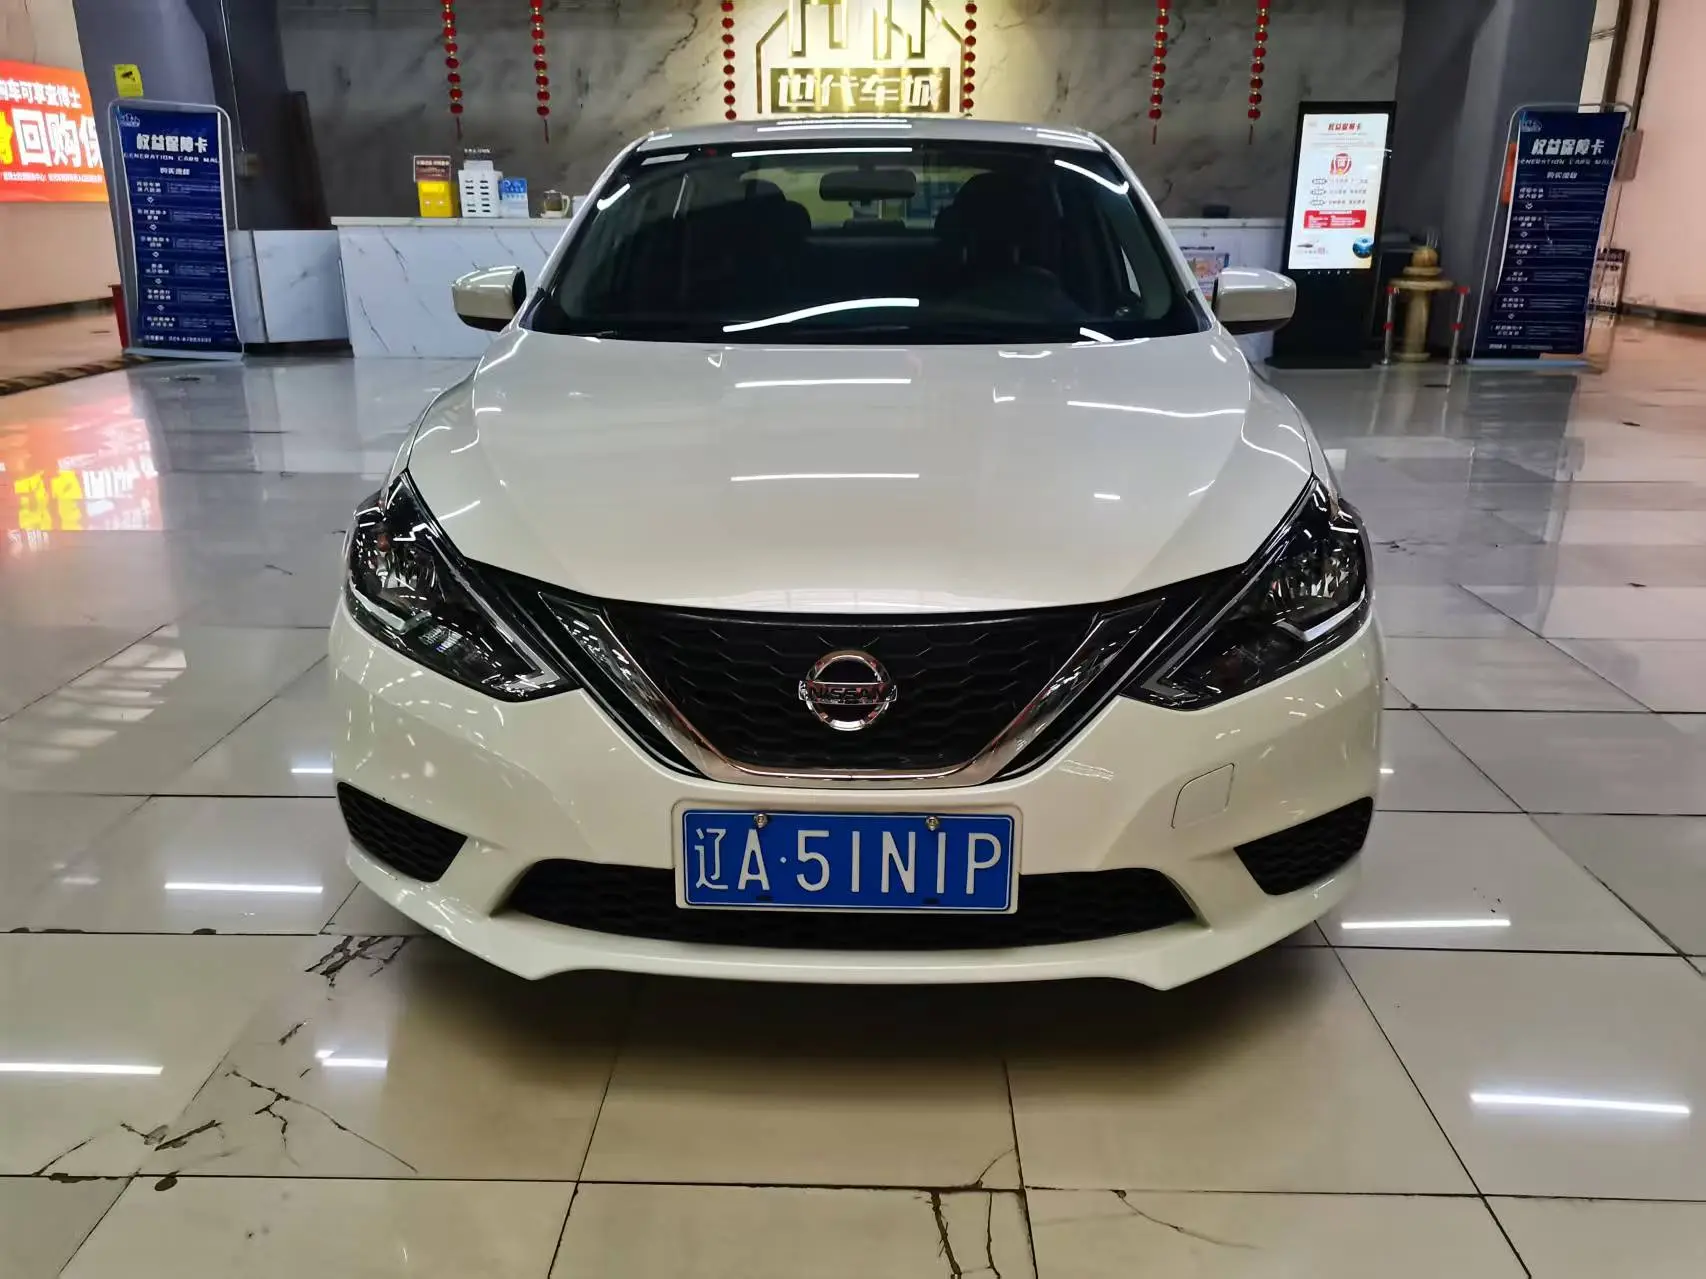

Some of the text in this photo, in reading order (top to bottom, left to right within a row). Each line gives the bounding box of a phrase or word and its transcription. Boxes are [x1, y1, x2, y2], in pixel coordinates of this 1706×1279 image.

[778, 74, 942, 107] 世代车城
[136, 133, 208, 153] 权益保障卡
[1531, 138, 1605, 156] 权益保障卡
[808, 685, 886, 701] NISSAN
